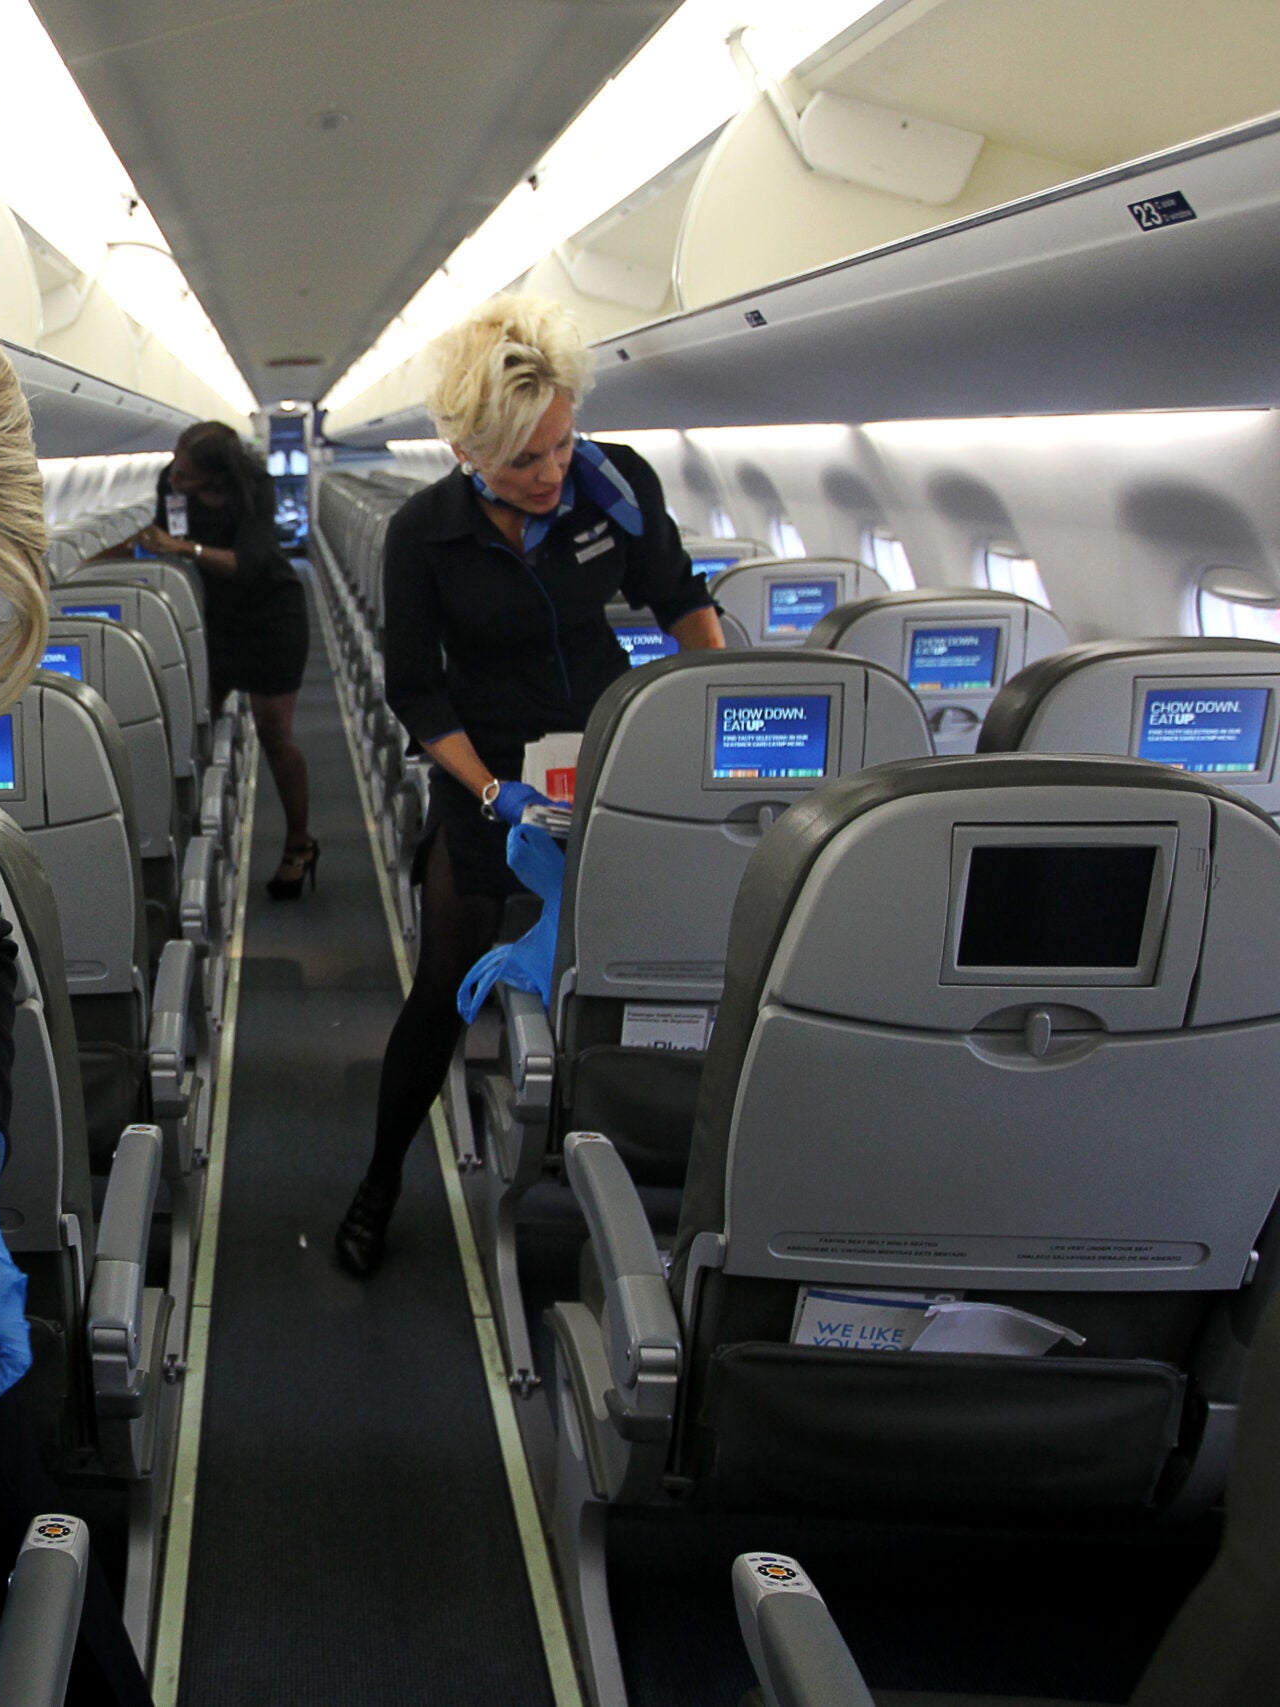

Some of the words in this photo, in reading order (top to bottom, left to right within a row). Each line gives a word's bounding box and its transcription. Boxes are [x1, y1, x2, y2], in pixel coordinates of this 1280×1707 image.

[1133, 202, 1162, 227] 23
[723, 708, 762, 720] CHOW
[764, 707, 807, 720] DOWN.
[1150, 701, 1193, 714] CHOW
[1195, 701, 1242, 713] DOWN.
[1149, 713, 1196, 725] EATUP.
[723, 720, 766, 732] EATUP.
[817, 1321, 854, 1338] WE
[859, 1326, 905, 1343] LIKE
